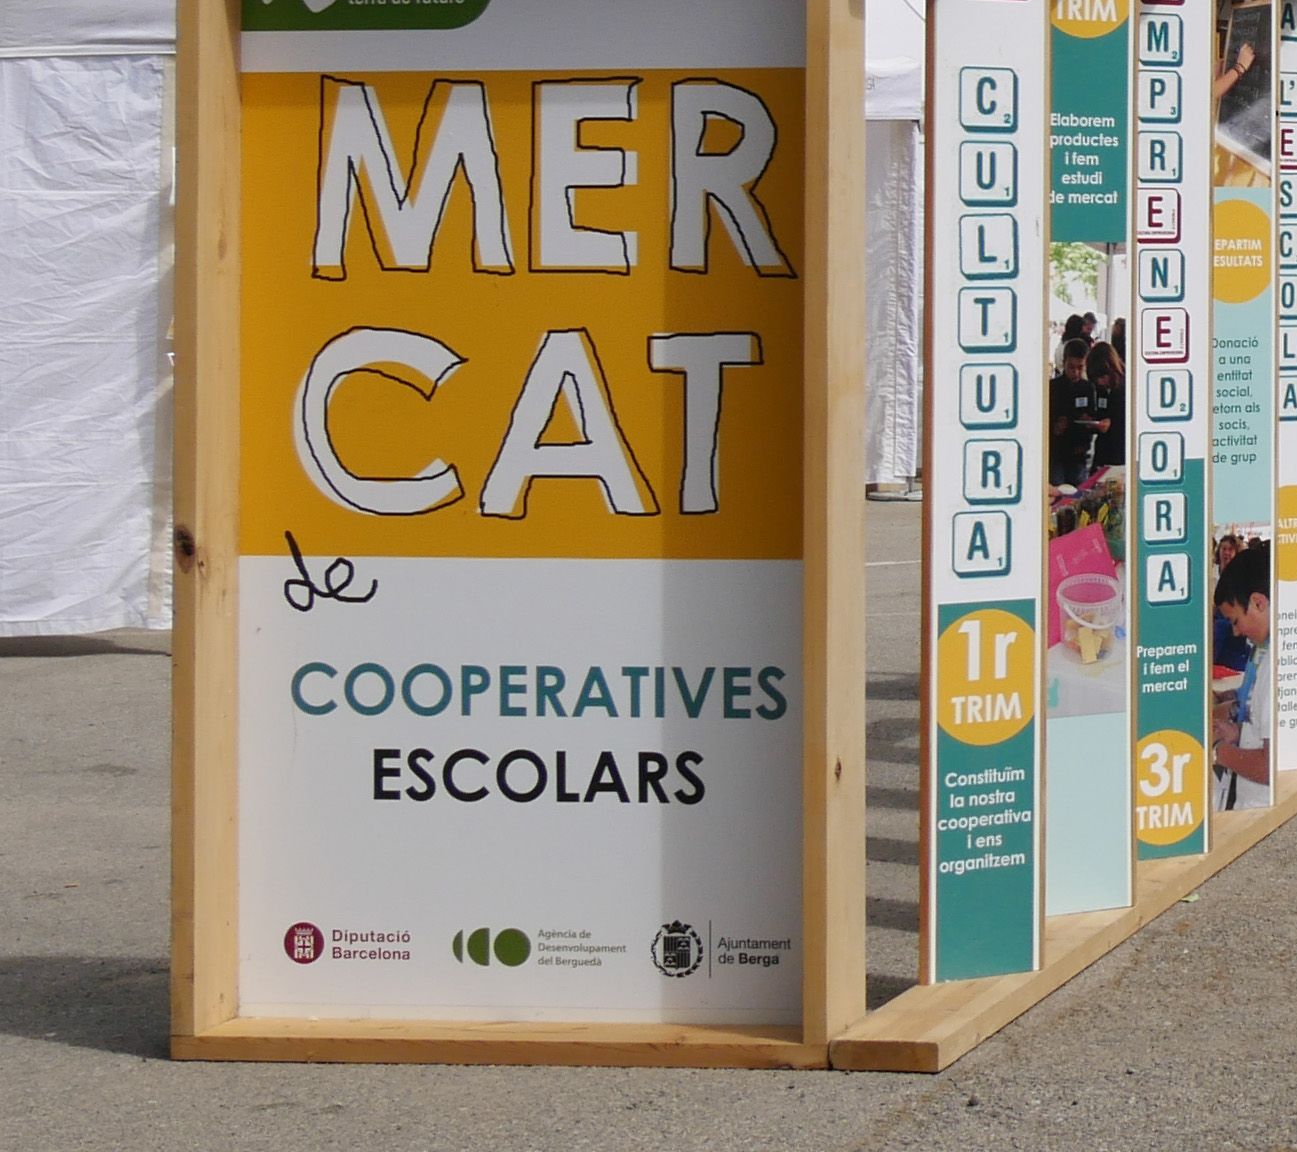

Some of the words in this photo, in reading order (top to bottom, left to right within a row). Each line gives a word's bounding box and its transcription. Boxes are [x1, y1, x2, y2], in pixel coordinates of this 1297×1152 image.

[1050, 113, 1115, 128] Elaborem
[1049, 132, 1120, 149] productes
[1064, 151, 1069, 165] i
[1072, 151, 1100, 166] fem
[309, 74, 799, 282] MER
[1061, 171, 1103, 185] estudi
[1068, 190, 1119, 204] mercat
[1214, 239, 1263, 251] EPARTIM
[1213, 255, 1264, 267] ESULTATS
[1218, 356, 1226, 365] a
[1229, 355, 1251, 365] una
[1217, 369, 1253, 382] entitat
[1212, 404, 1242, 415] etorn
[1244, 402, 1261, 413] als
[291, 326, 765, 520] CAT
[1212, 434, 1258, 447] activitat
[1212, 452, 1227, 464] de
[1231, 452, 1257, 465] grup
[284, 530, 378, 612] de
[957, 619, 1018, 682] 1r
[1136, 643, 1197, 660] Preparem
[1143, 663, 1148, 675] i
[1150, 661, 1175, 675] fem
[1177, 659, 1190, 672] el
[290, 661, 789, 721] COOPERATIVES
[1142, 677, 1188, 693] mercat
[951, 692, 1023, 725] TRIM
[373, 747, 706, 806] ESCOLARS
[944, 766, 1025, 788] Constituïm
[1139, 742, 1192, 797] 3r
[949, 793, 965, 809] la
[968, 789, 1016, 807] nostra
[937, 808, 1032, 832] cooperativa
[1136, 801, 1194, 830] TRIM
[966, 834, 972, 849] i
[975, 833, 1003, 847] ens
[939, 850, 1026, 875] organitzem
[332, 928, 411, 945] Diputació
[537, 928, 577, 941] Agència
[579, 929, 592, 939] de
[538, 942, 627, 954] Desenvolupament
[717, 936, 792, 951] Ajuntament
[332, 946, 411, 961] Barcelona
[718, 953, 735, 965] de
[738, 953, 780, 967] Berga
[537, 956, 553, 966] del
[555, 956, 602, 968] Berguedà
